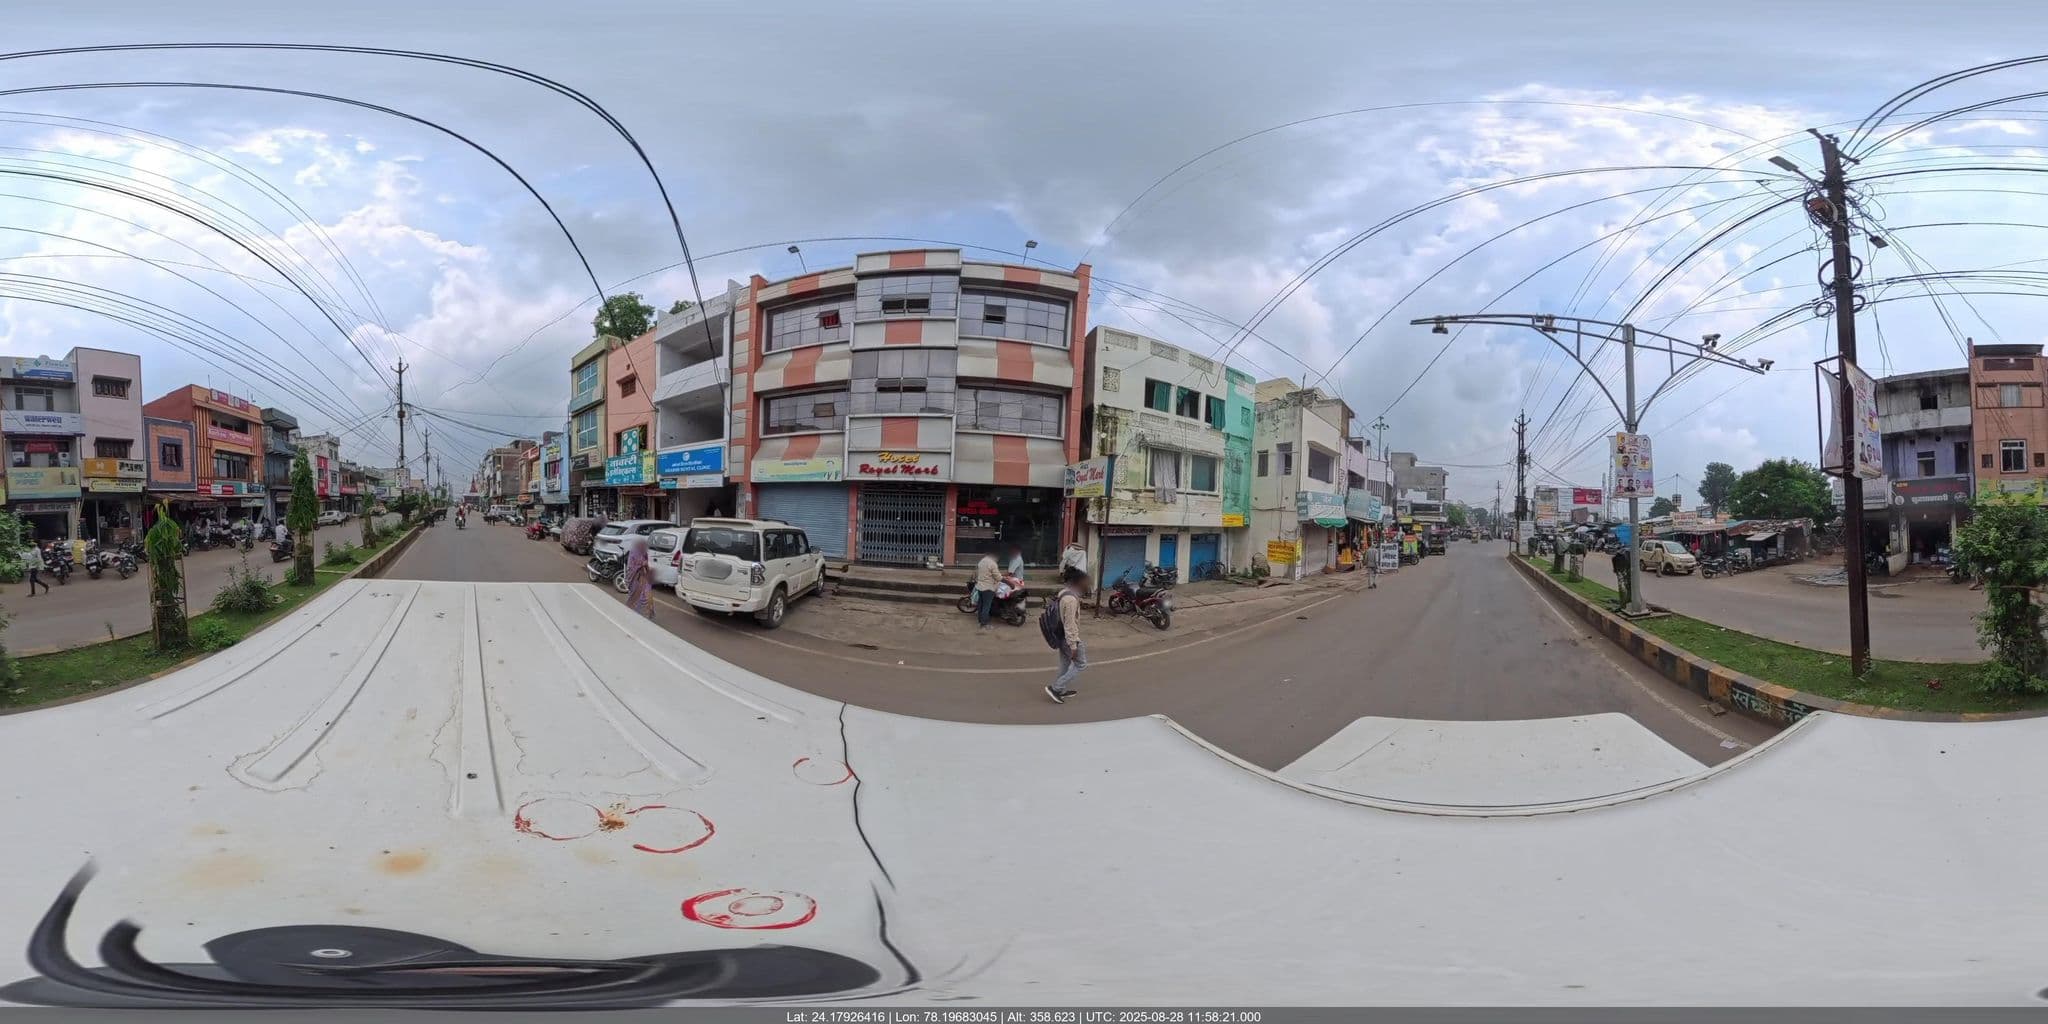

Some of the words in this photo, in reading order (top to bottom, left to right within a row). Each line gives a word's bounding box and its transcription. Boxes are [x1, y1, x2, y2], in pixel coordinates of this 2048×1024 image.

[879, 452, 920, 463] Hotel
[859, 464, 898, 477] Royal
[900, 464, 938, 475] Mark
